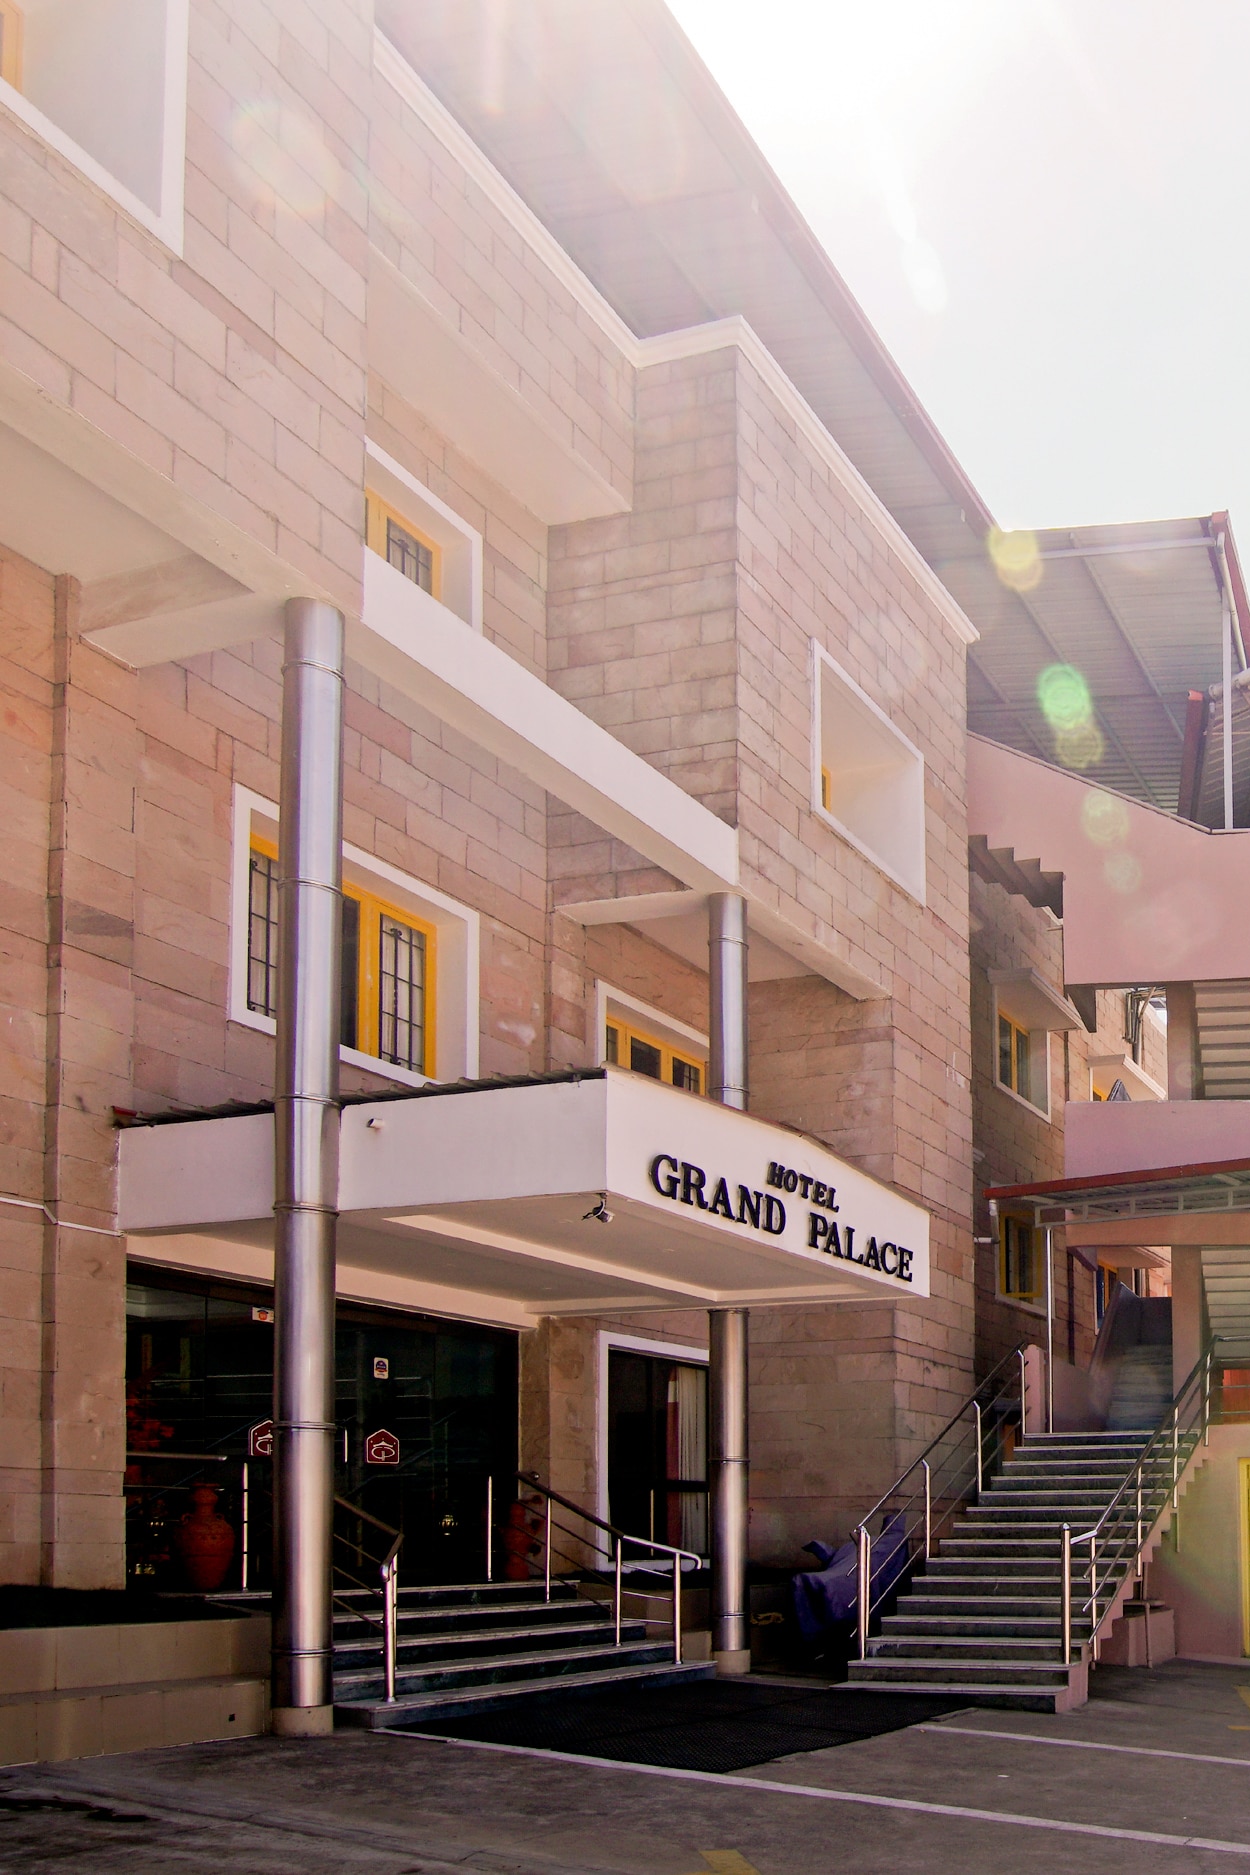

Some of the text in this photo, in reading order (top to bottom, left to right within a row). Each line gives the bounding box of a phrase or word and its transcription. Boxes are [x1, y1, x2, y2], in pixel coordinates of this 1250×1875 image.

[650, 1154, 914, 1283] GRAND PALACE
[766, 1161, 839, 1213] HOTEL
